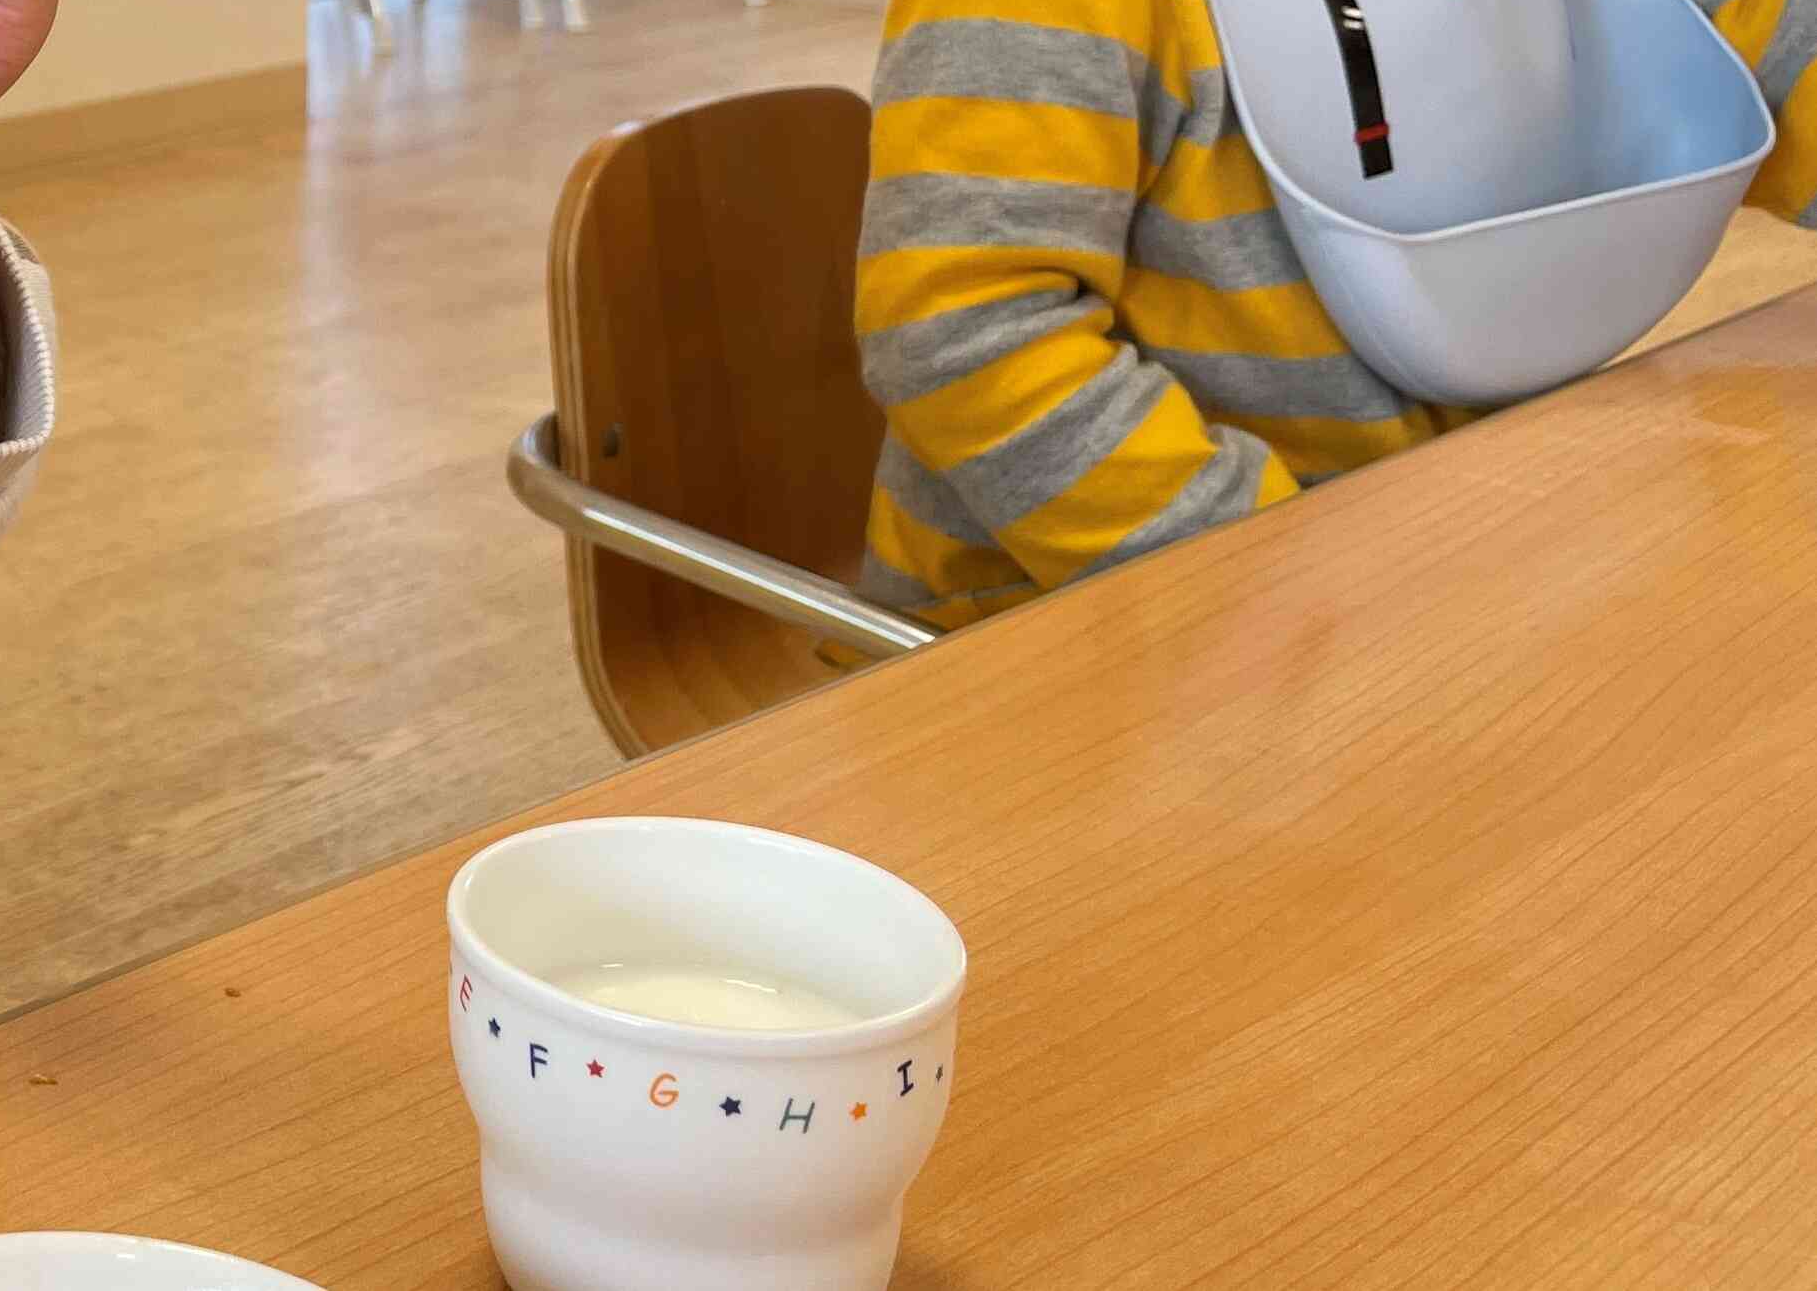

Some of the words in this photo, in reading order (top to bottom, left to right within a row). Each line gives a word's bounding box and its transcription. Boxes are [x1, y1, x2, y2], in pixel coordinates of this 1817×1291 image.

[459, 974, 473, 1012] E
[529, 1041, 549, 1079] F
[649, 1072, 679, 1107] G
[779, 1098, 816, 1134] H
[896, 1060, 914, 1097] I
